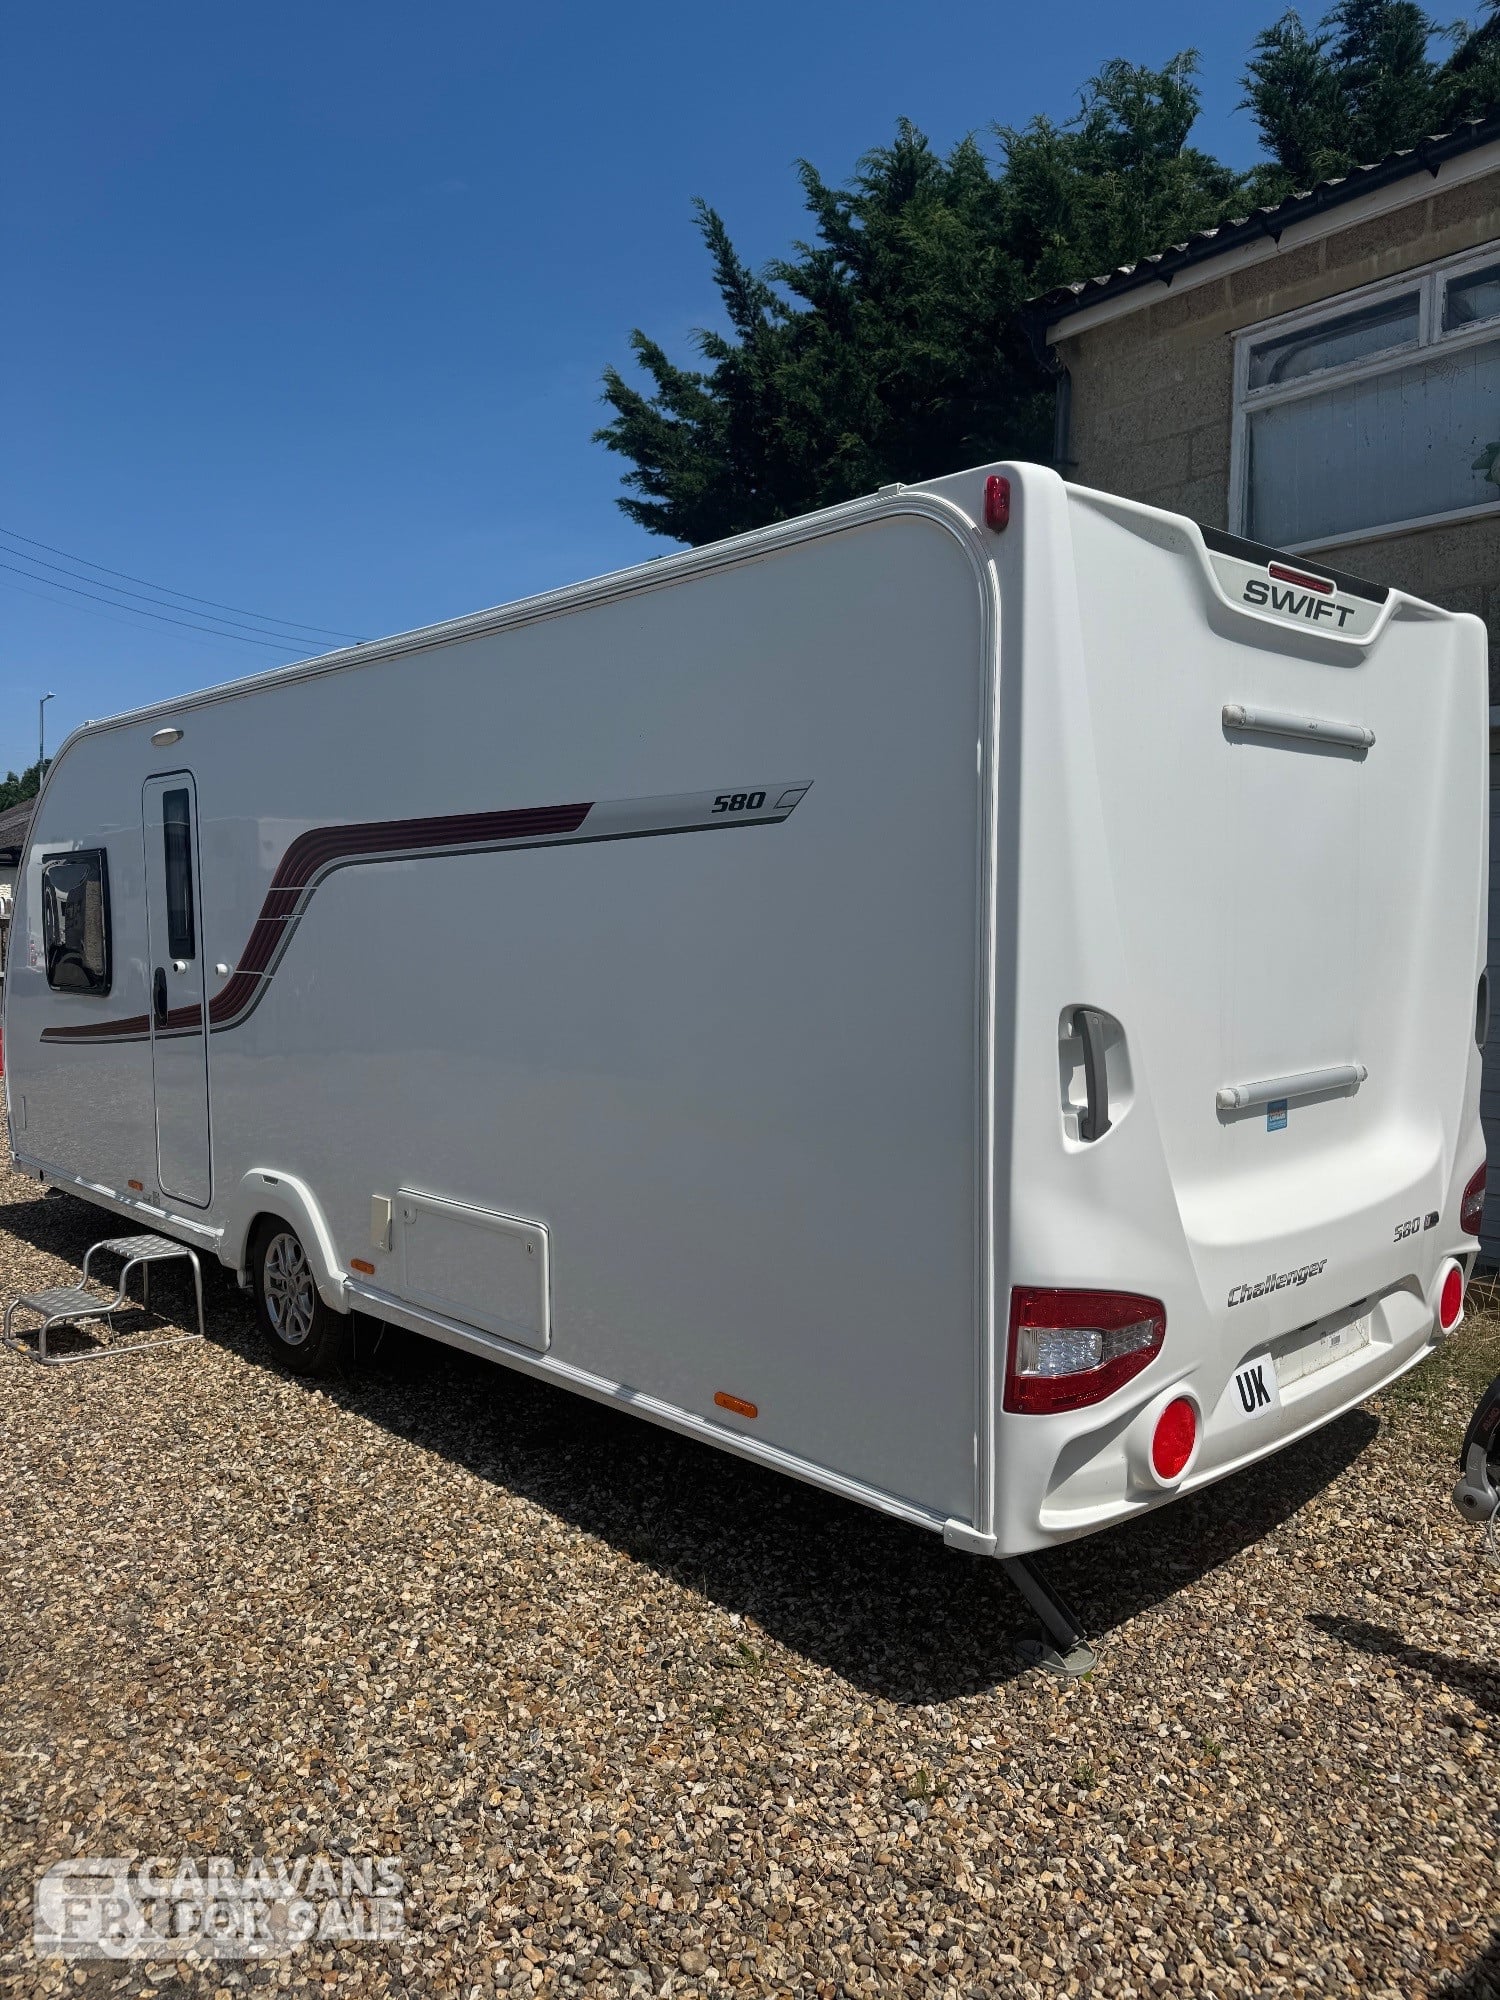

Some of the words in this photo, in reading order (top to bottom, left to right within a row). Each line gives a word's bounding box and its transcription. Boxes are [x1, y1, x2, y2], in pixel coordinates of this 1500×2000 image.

[1242, 579, 1356, 628] SWIFT
[711, 791, 767, 814] 580
[1393, 1216, 1421, 1243] 580
[1227, 1259, 1328, 1308] Challenger
[1235, 1365, 1271, 1413] UK
